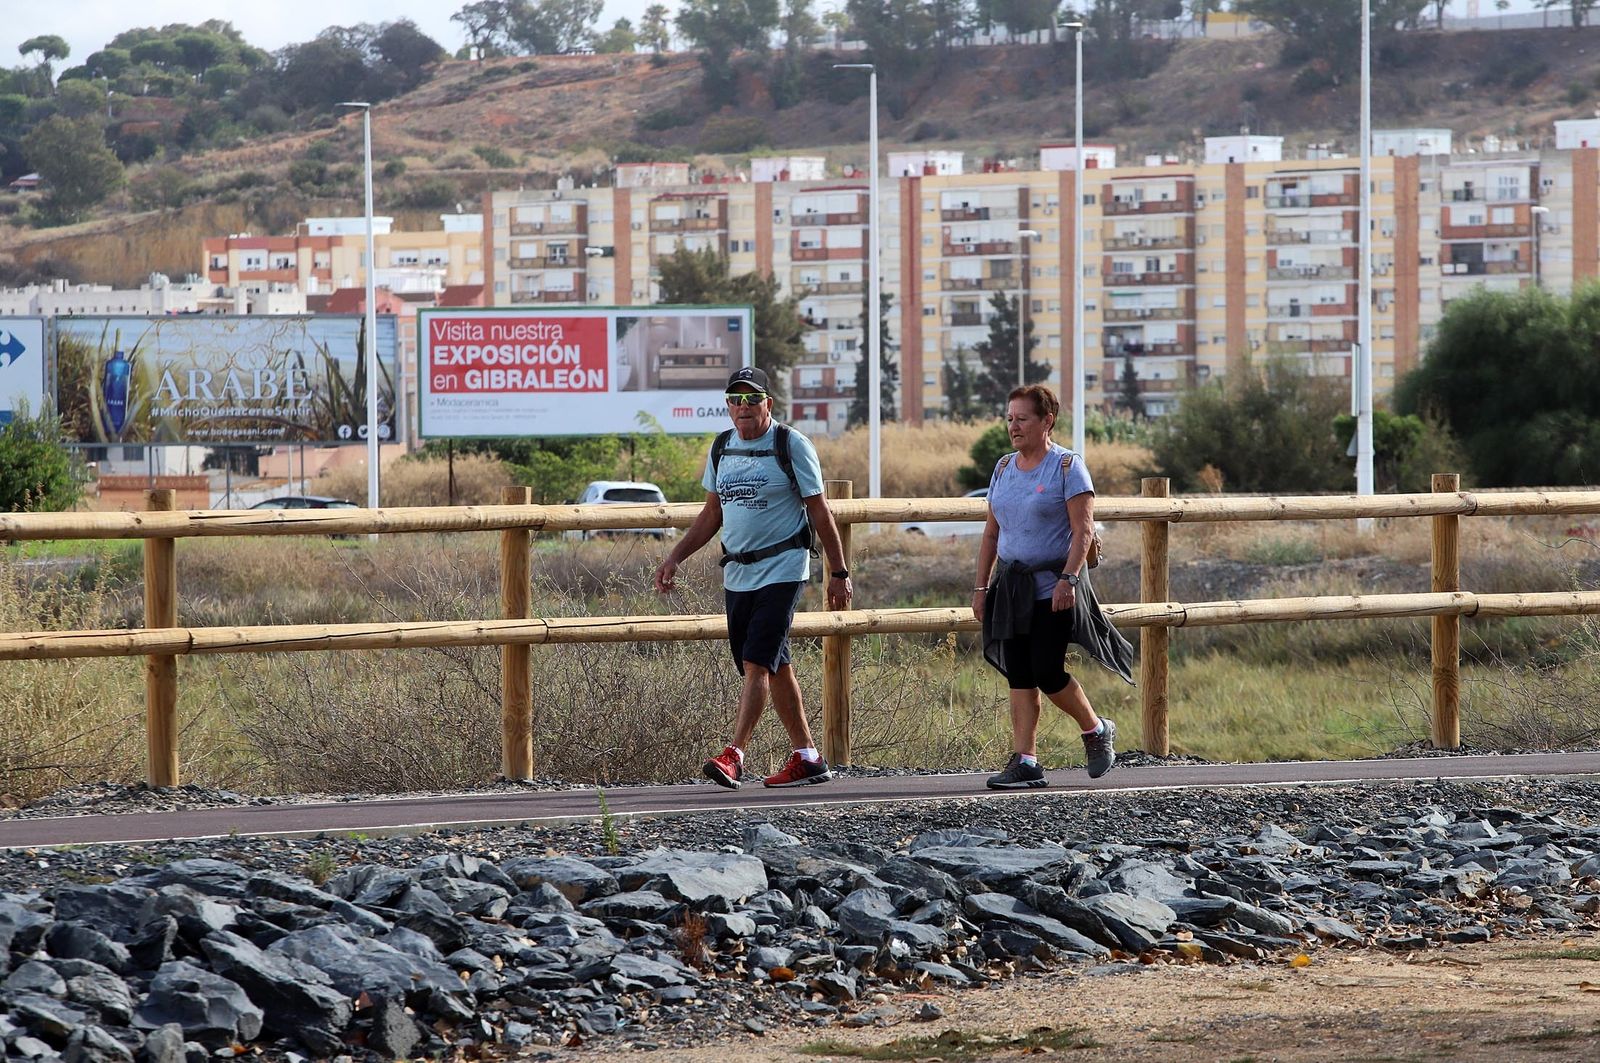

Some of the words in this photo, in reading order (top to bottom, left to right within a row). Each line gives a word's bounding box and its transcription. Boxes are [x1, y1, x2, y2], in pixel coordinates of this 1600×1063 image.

[432, 320, 484, 341] Visita
[490, 321, 564, 340] nuestra
[433, 340, 581, 366] EXPOSICIÓN
[433, 374, 458, 390] en
[464, 365, 604, 389] GIBRALEÓN
[151, 405, 312, 418] #MuchoQueHacerteSentir
[719, 488, 758, 505] Superior
